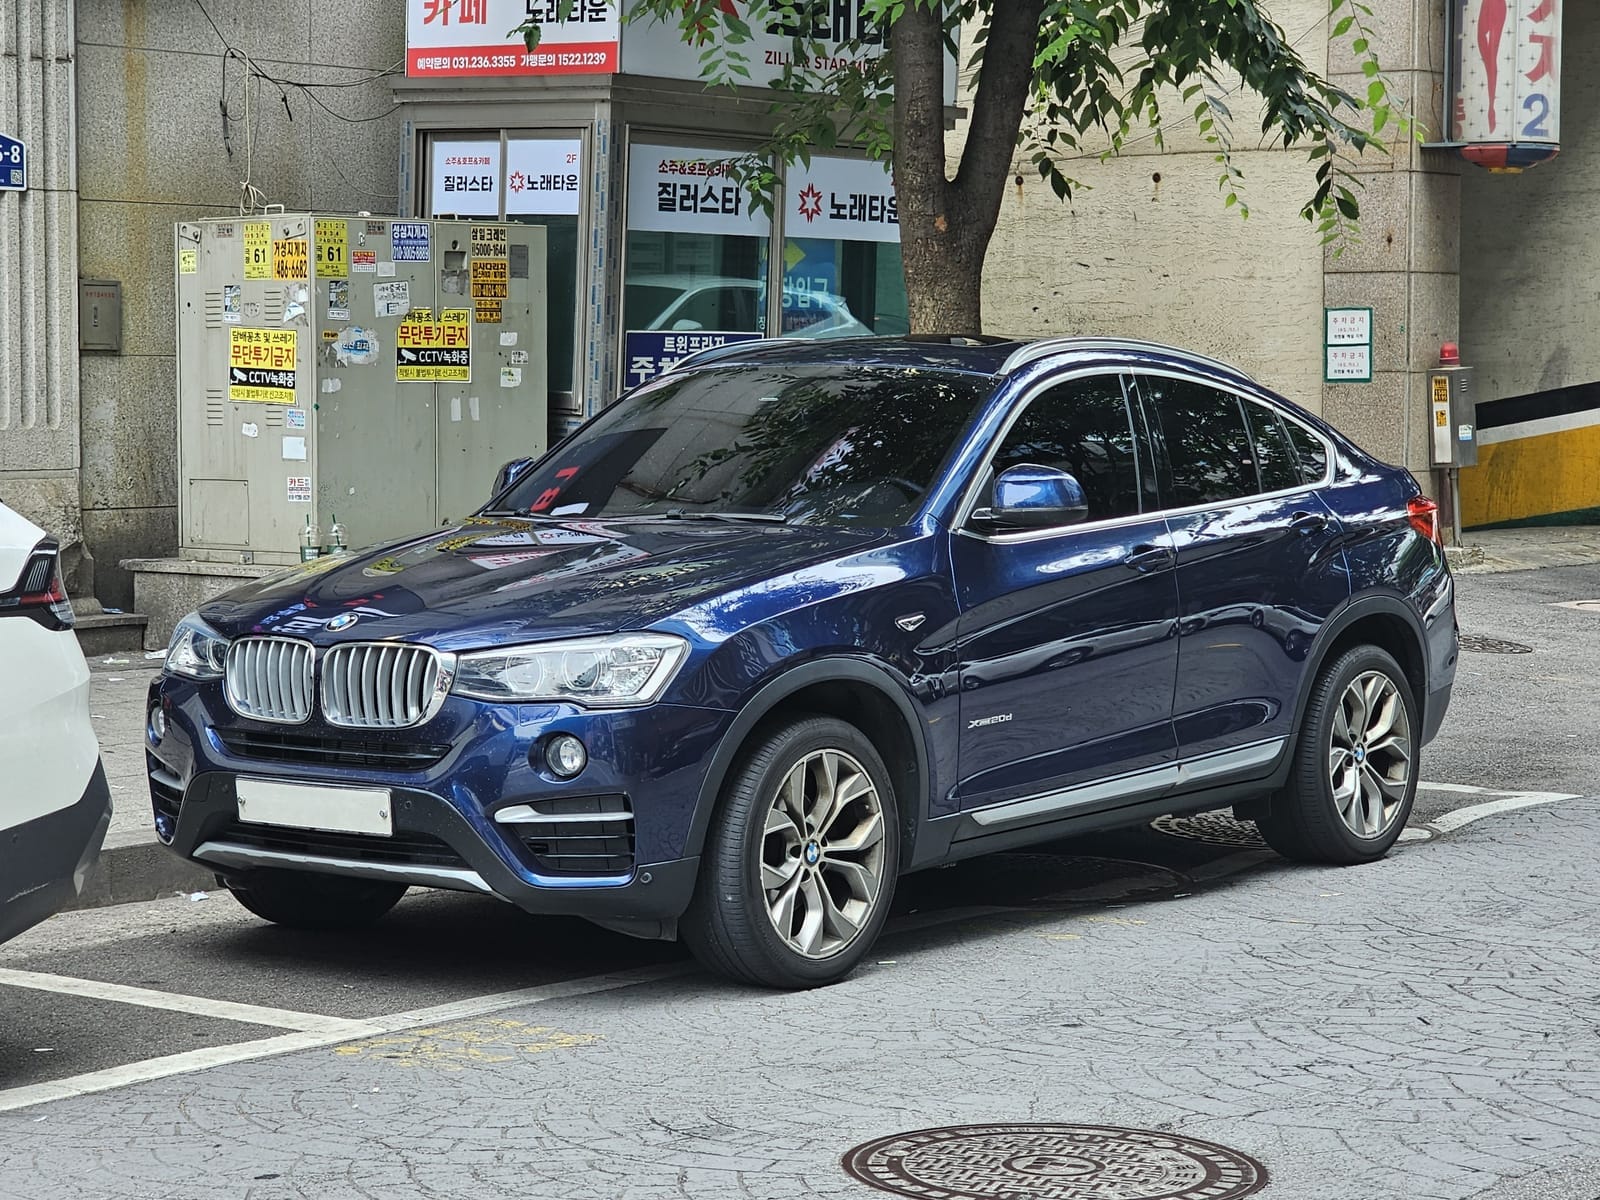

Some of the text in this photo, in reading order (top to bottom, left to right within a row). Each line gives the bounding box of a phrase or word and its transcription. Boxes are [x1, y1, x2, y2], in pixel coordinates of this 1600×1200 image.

[417, 52, 607, 70] 예약문의 031.236.3355 가맹문의 1522.1239
[1521, 93, 1550, 137] 2
[445, 157, 491, 165] 소주&호프&카페
[566, 154, 577, 164] 2F
[444, 175, 494, 192] 질러스타
[527, 174, 578, 191] 노래타운
[657, 182, 742, 216] 질러스타
[254, 248, 267, 263] 61
[327, 246, 341, 262] 61
[445, 312, 468, 323] 쓰레기
[232, 331, 295, 344] 담배꽁초 및 쓰레기
[399, 325, 468, 346] 무단투기금지
[232, 344, 295, 368] 무단투기금지
[419, 350, 469, 365] CCTV녹화중
[248, 371, 294, 387] CCTV녹화중
